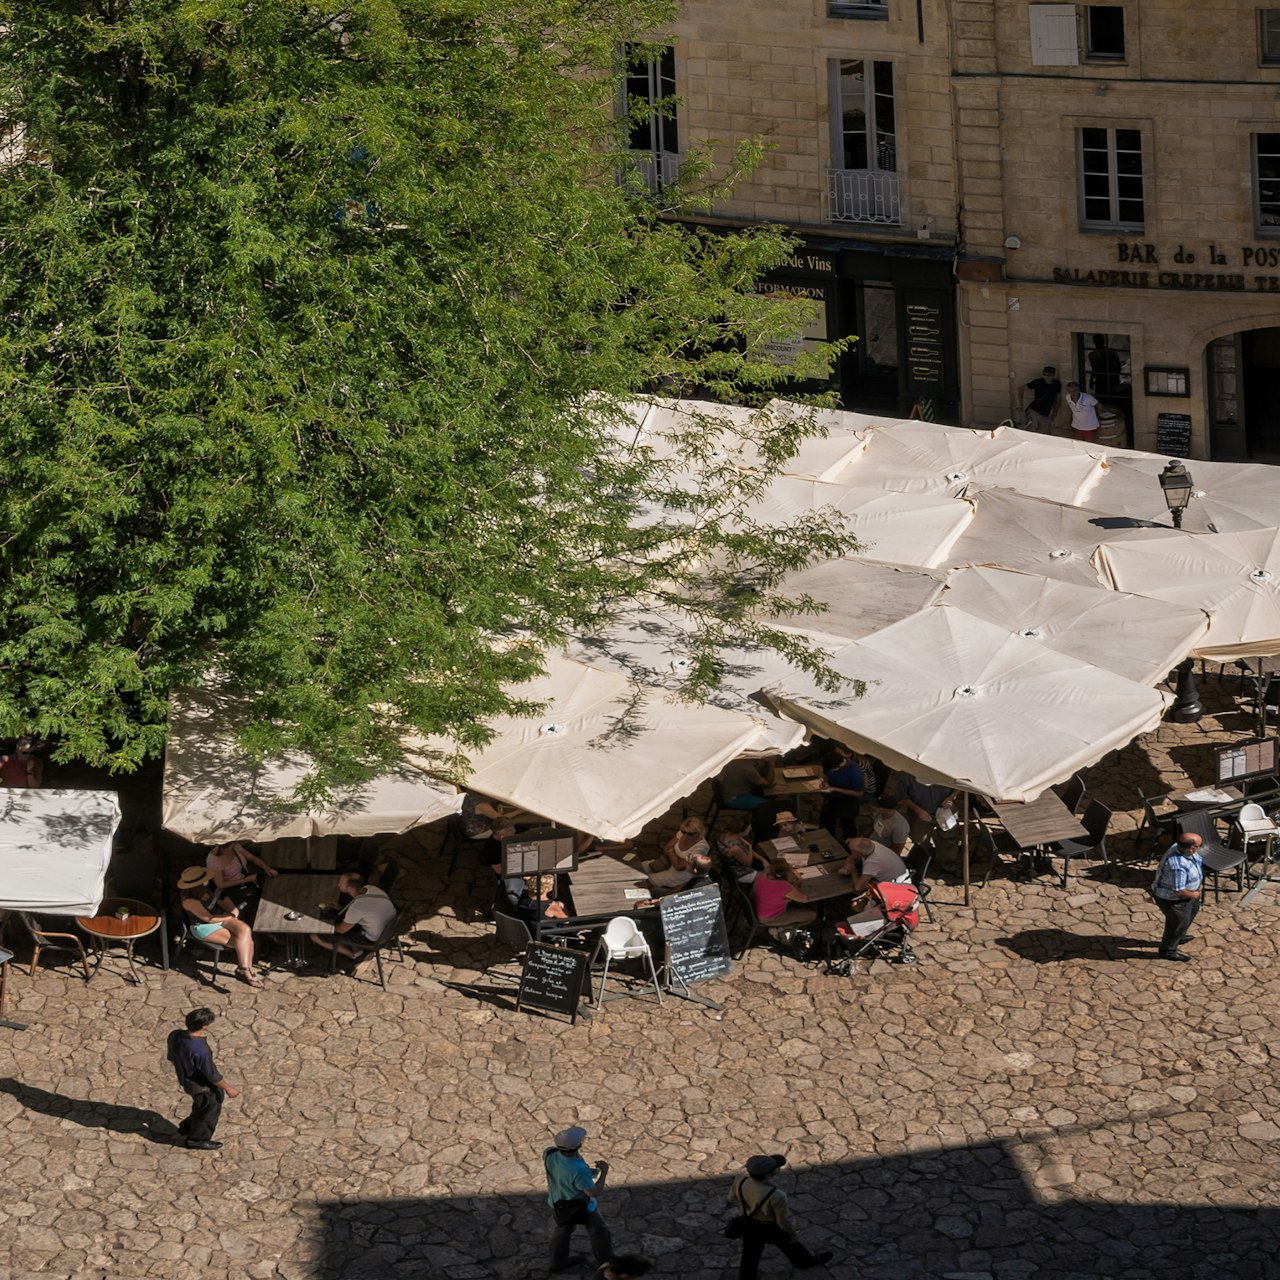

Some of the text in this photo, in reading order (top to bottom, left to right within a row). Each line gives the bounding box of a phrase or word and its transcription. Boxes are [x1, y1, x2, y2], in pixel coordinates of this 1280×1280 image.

[807, 256, 832, 271] Vins
[1118, 243, 1158, 264] BAR
[1174, 245, 1195, 264] de
[1209, 245, 1227, 265] la
[1052, 268, 1150, 287] SALADERIE
[1158, 272, 1244, 290] CREPERIE
[752, 282, 824, 298] NFORMATION
